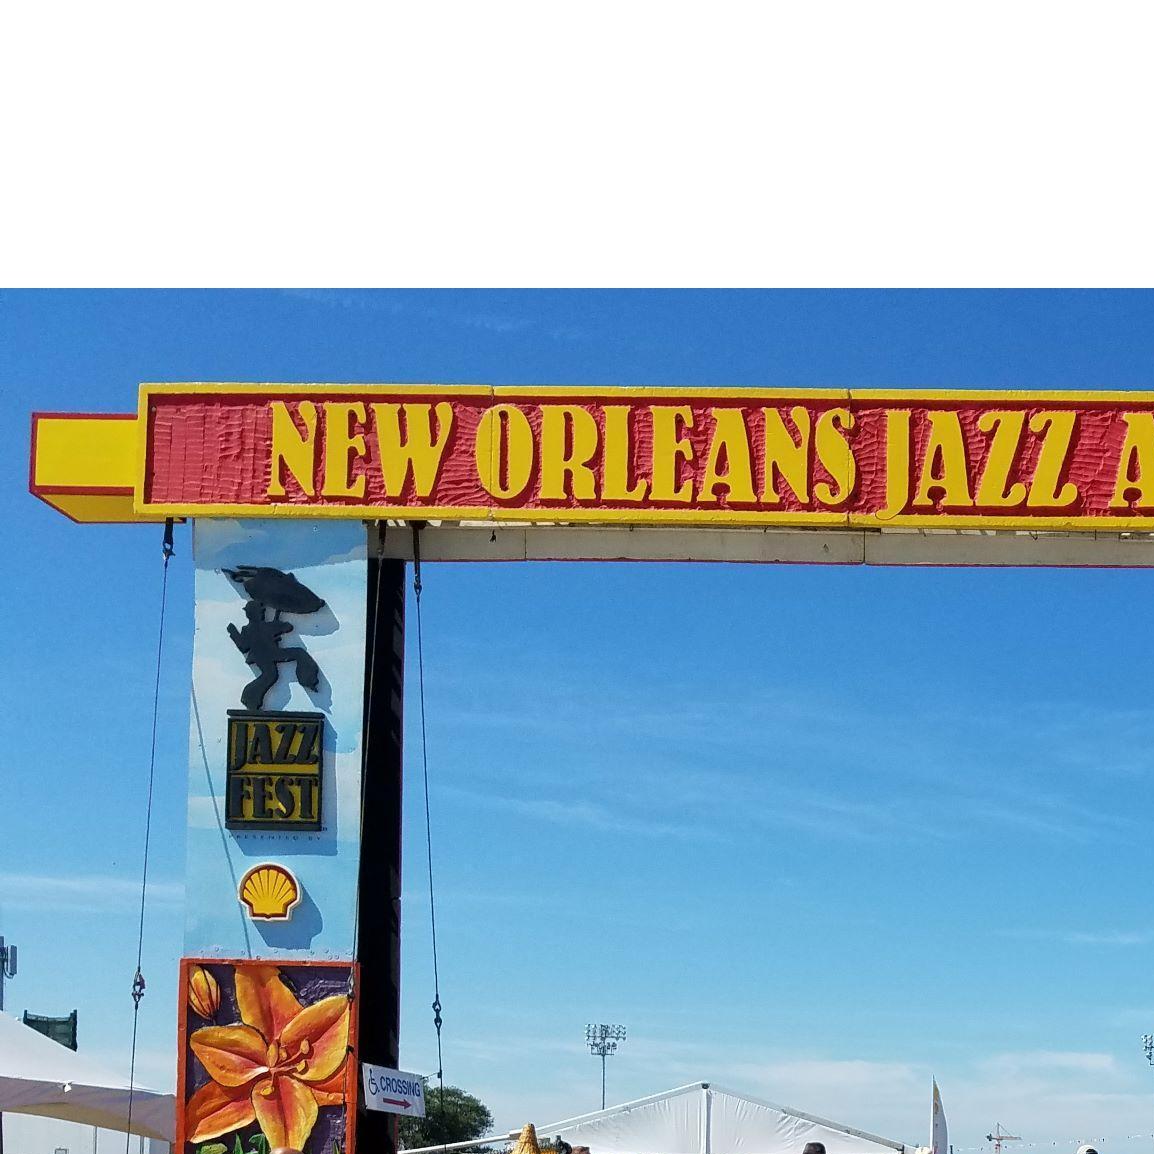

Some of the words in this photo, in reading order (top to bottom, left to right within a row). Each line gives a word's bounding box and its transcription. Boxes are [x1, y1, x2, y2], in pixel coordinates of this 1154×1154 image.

[267, 400, 454, 500] NEW
[475, 403, 859, 505] ORLEANS
[875, 408, 1079, 520] JAZZ
[233, 722, 320, 770] JAZZ
[229, 776, 319, 820] FEST
[380, 1075, 421, 1097] CROSSING
